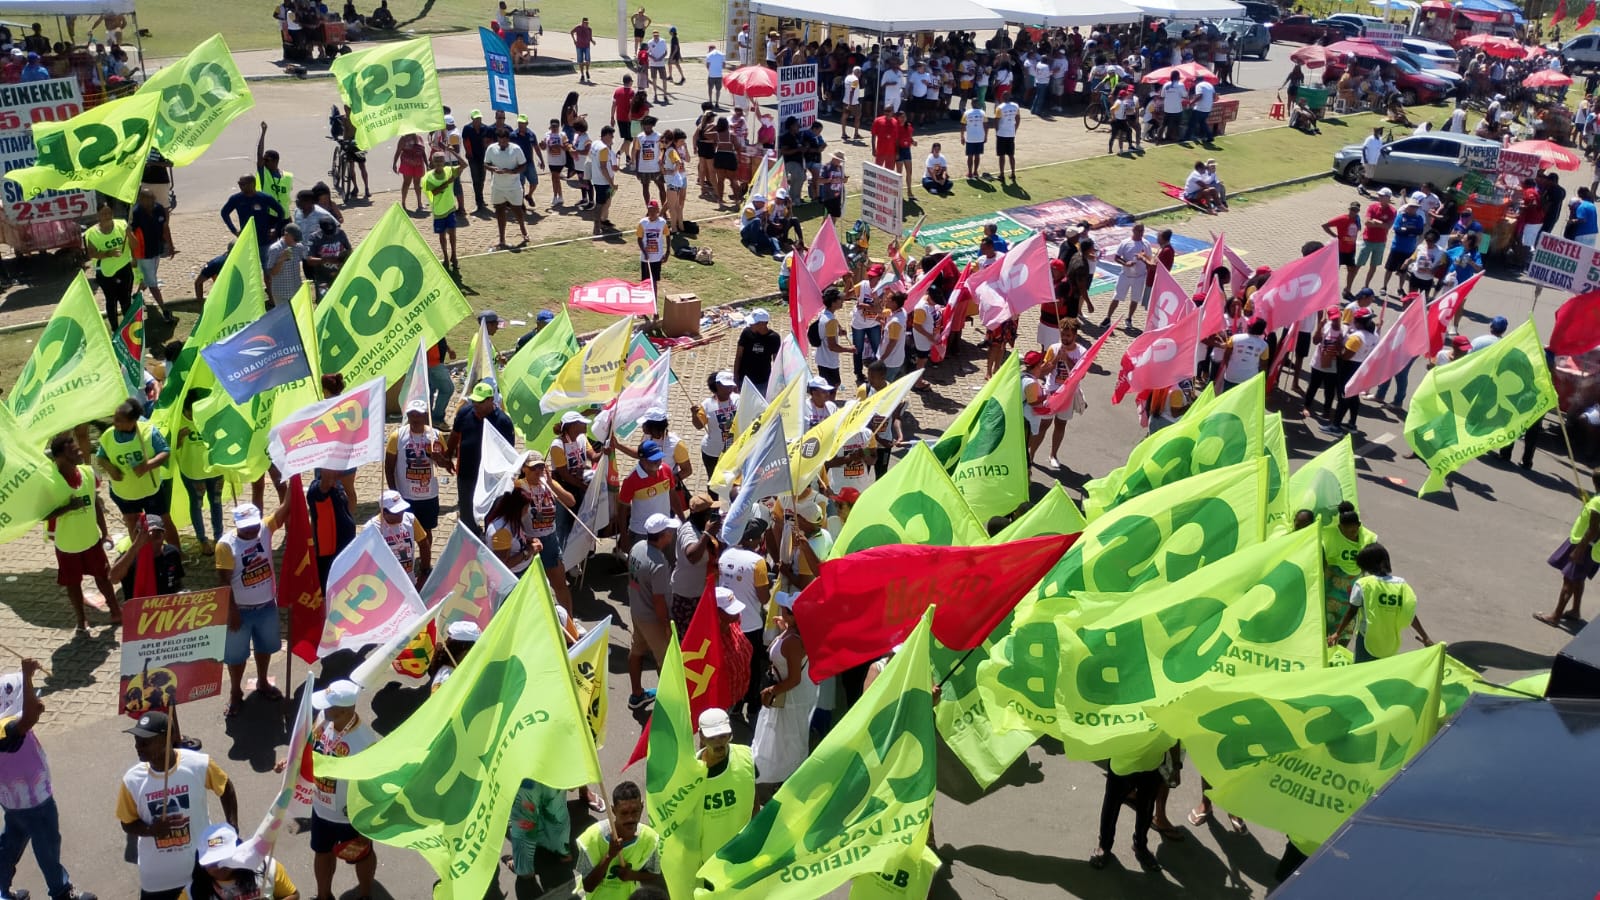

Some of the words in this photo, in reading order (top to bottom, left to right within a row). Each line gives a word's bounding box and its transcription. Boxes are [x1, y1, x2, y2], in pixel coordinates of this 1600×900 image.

[780, 65, 816, 82] HEINEKEN
[780, 80, 816, 98] 5.00
[105, 238, 123, 250] CSB
[1541, 235, 1582, 260] AMSTEL
[1549, 269, 1575, 290] BEATS
[116, 449, 145, 466] CSB
[1341, 549, 1359, 561] CS
[142, 591, 217, 609] MULHERES
[137, 602, 218, 636] VIVAS
[162, 639, 181, 647] PELO
[183, 637, 197, 645] FIM
[181, 640, 211, 650] CONTRA
[162, 650, 194, 660] MULHER
